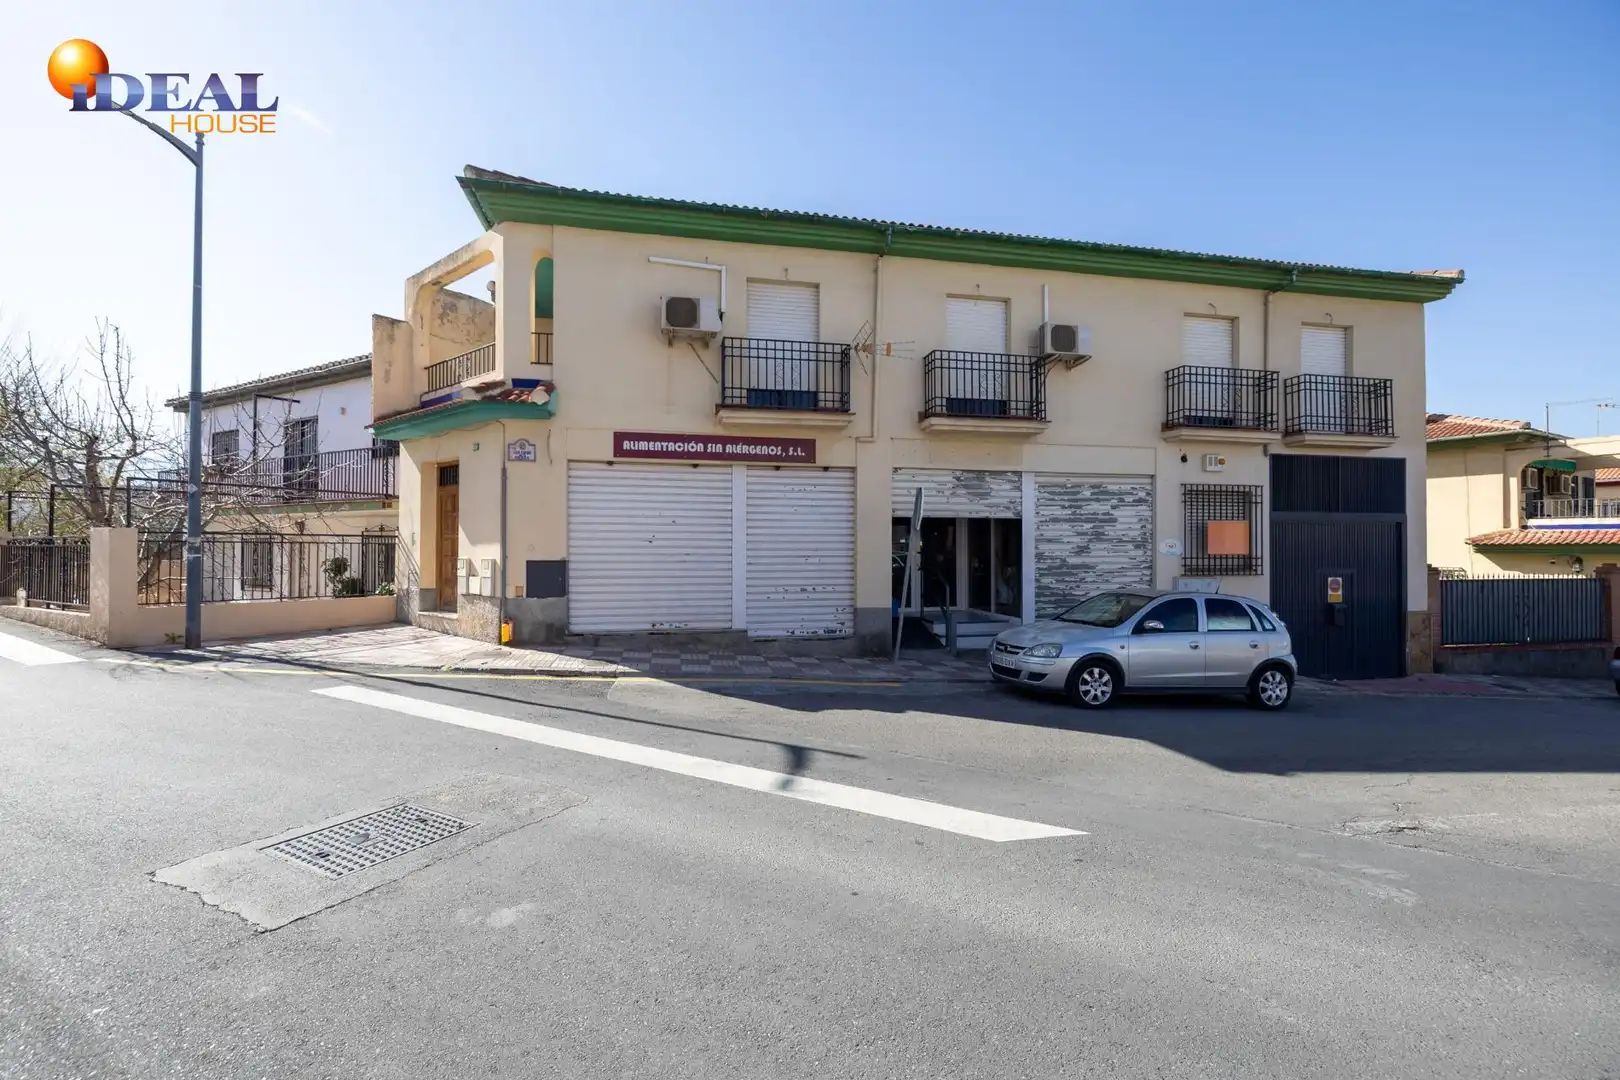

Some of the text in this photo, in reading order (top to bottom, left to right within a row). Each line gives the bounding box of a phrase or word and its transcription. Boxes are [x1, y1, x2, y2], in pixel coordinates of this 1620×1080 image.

[623, 440, 806, 457] ALIMENTACIÓN SIN ALÉRGENOS, S.L.
